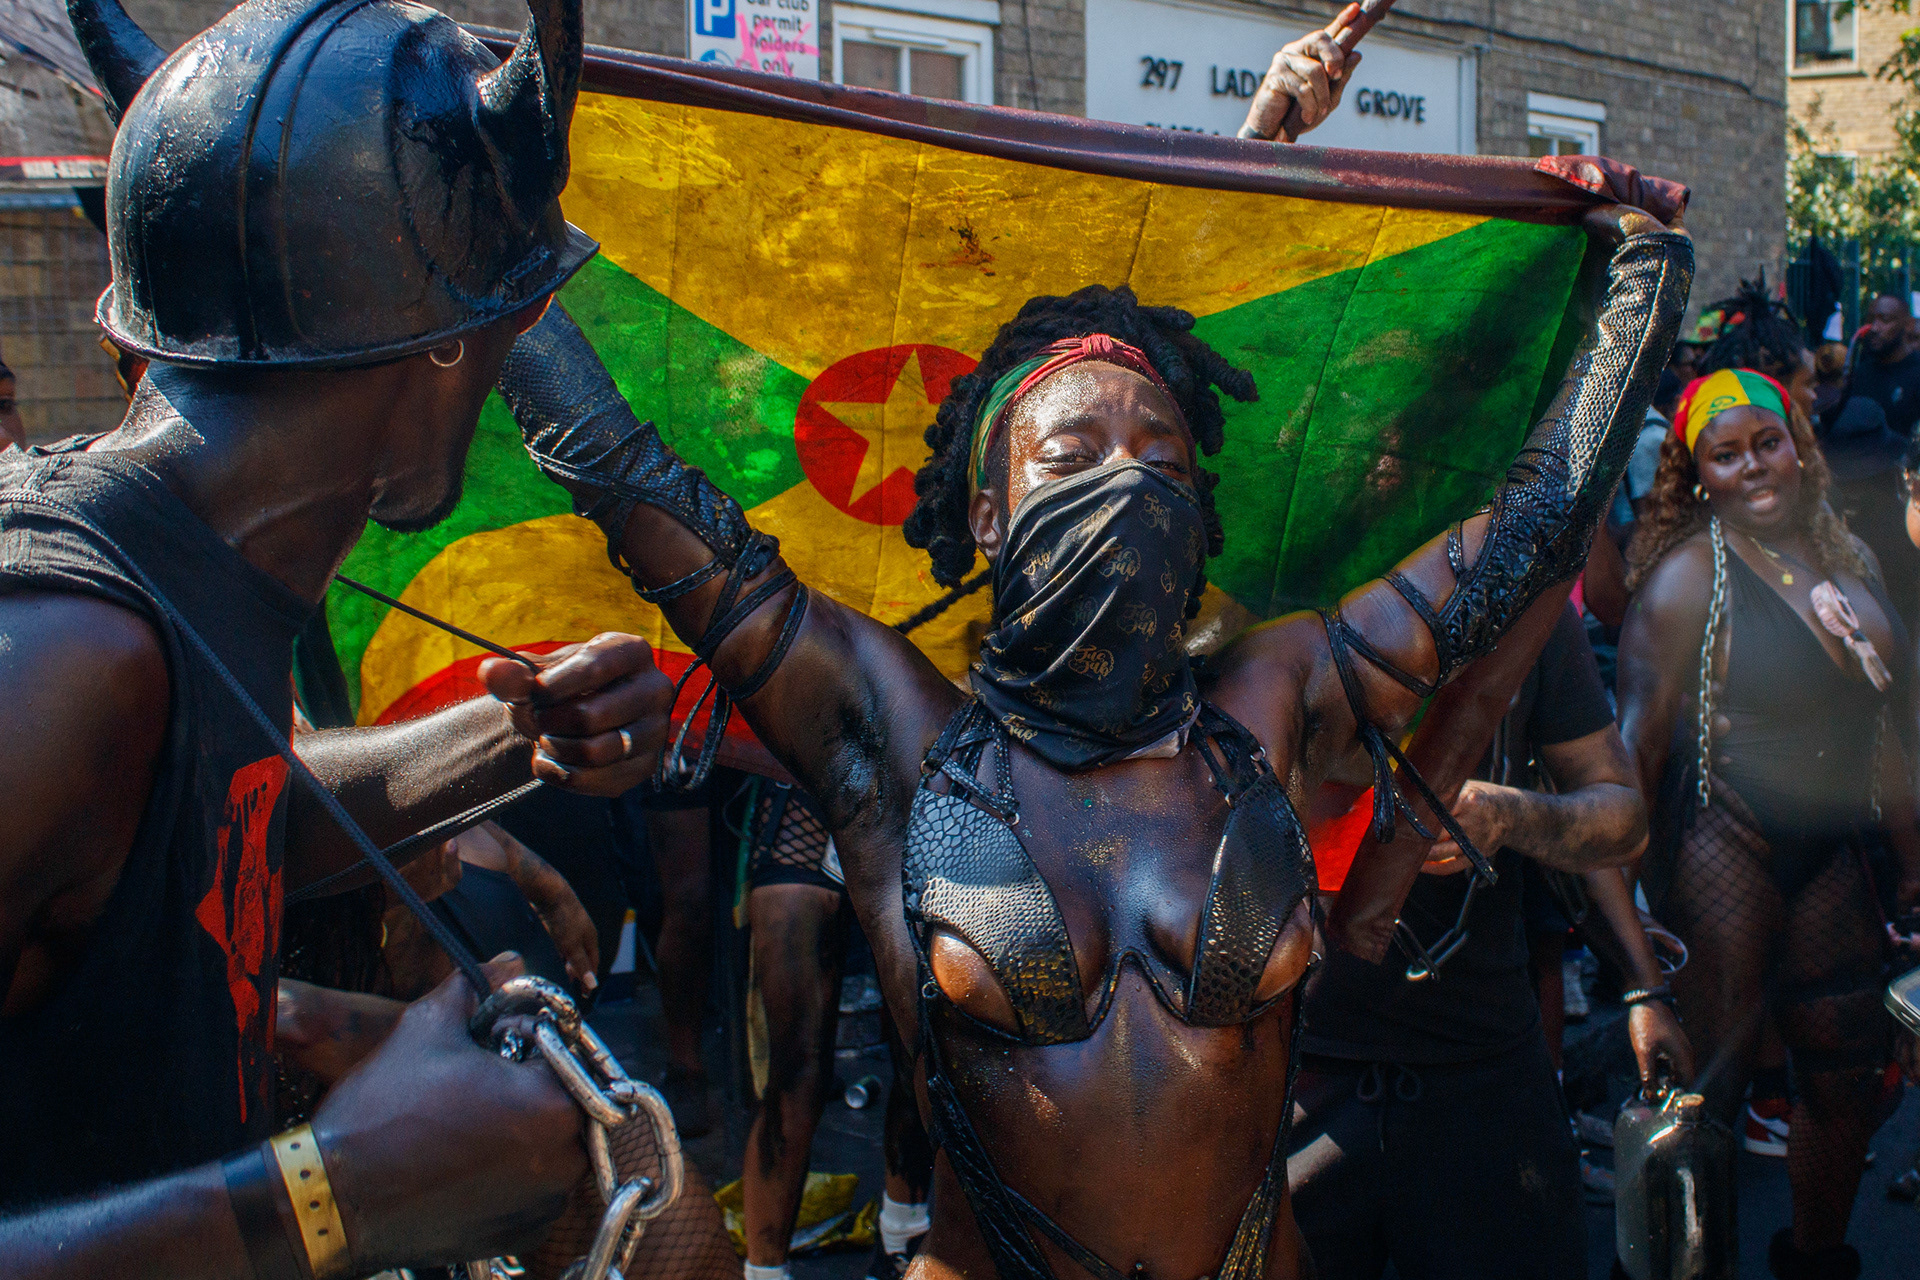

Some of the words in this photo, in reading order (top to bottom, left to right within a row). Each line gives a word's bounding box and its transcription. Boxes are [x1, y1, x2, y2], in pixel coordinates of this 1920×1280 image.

[753, 14, 802, 32] permit
[749, 31, 805, 54] holders
[1140, 56, 1183, 90] 297
[1356, 88, 1426, 123] GROVE
